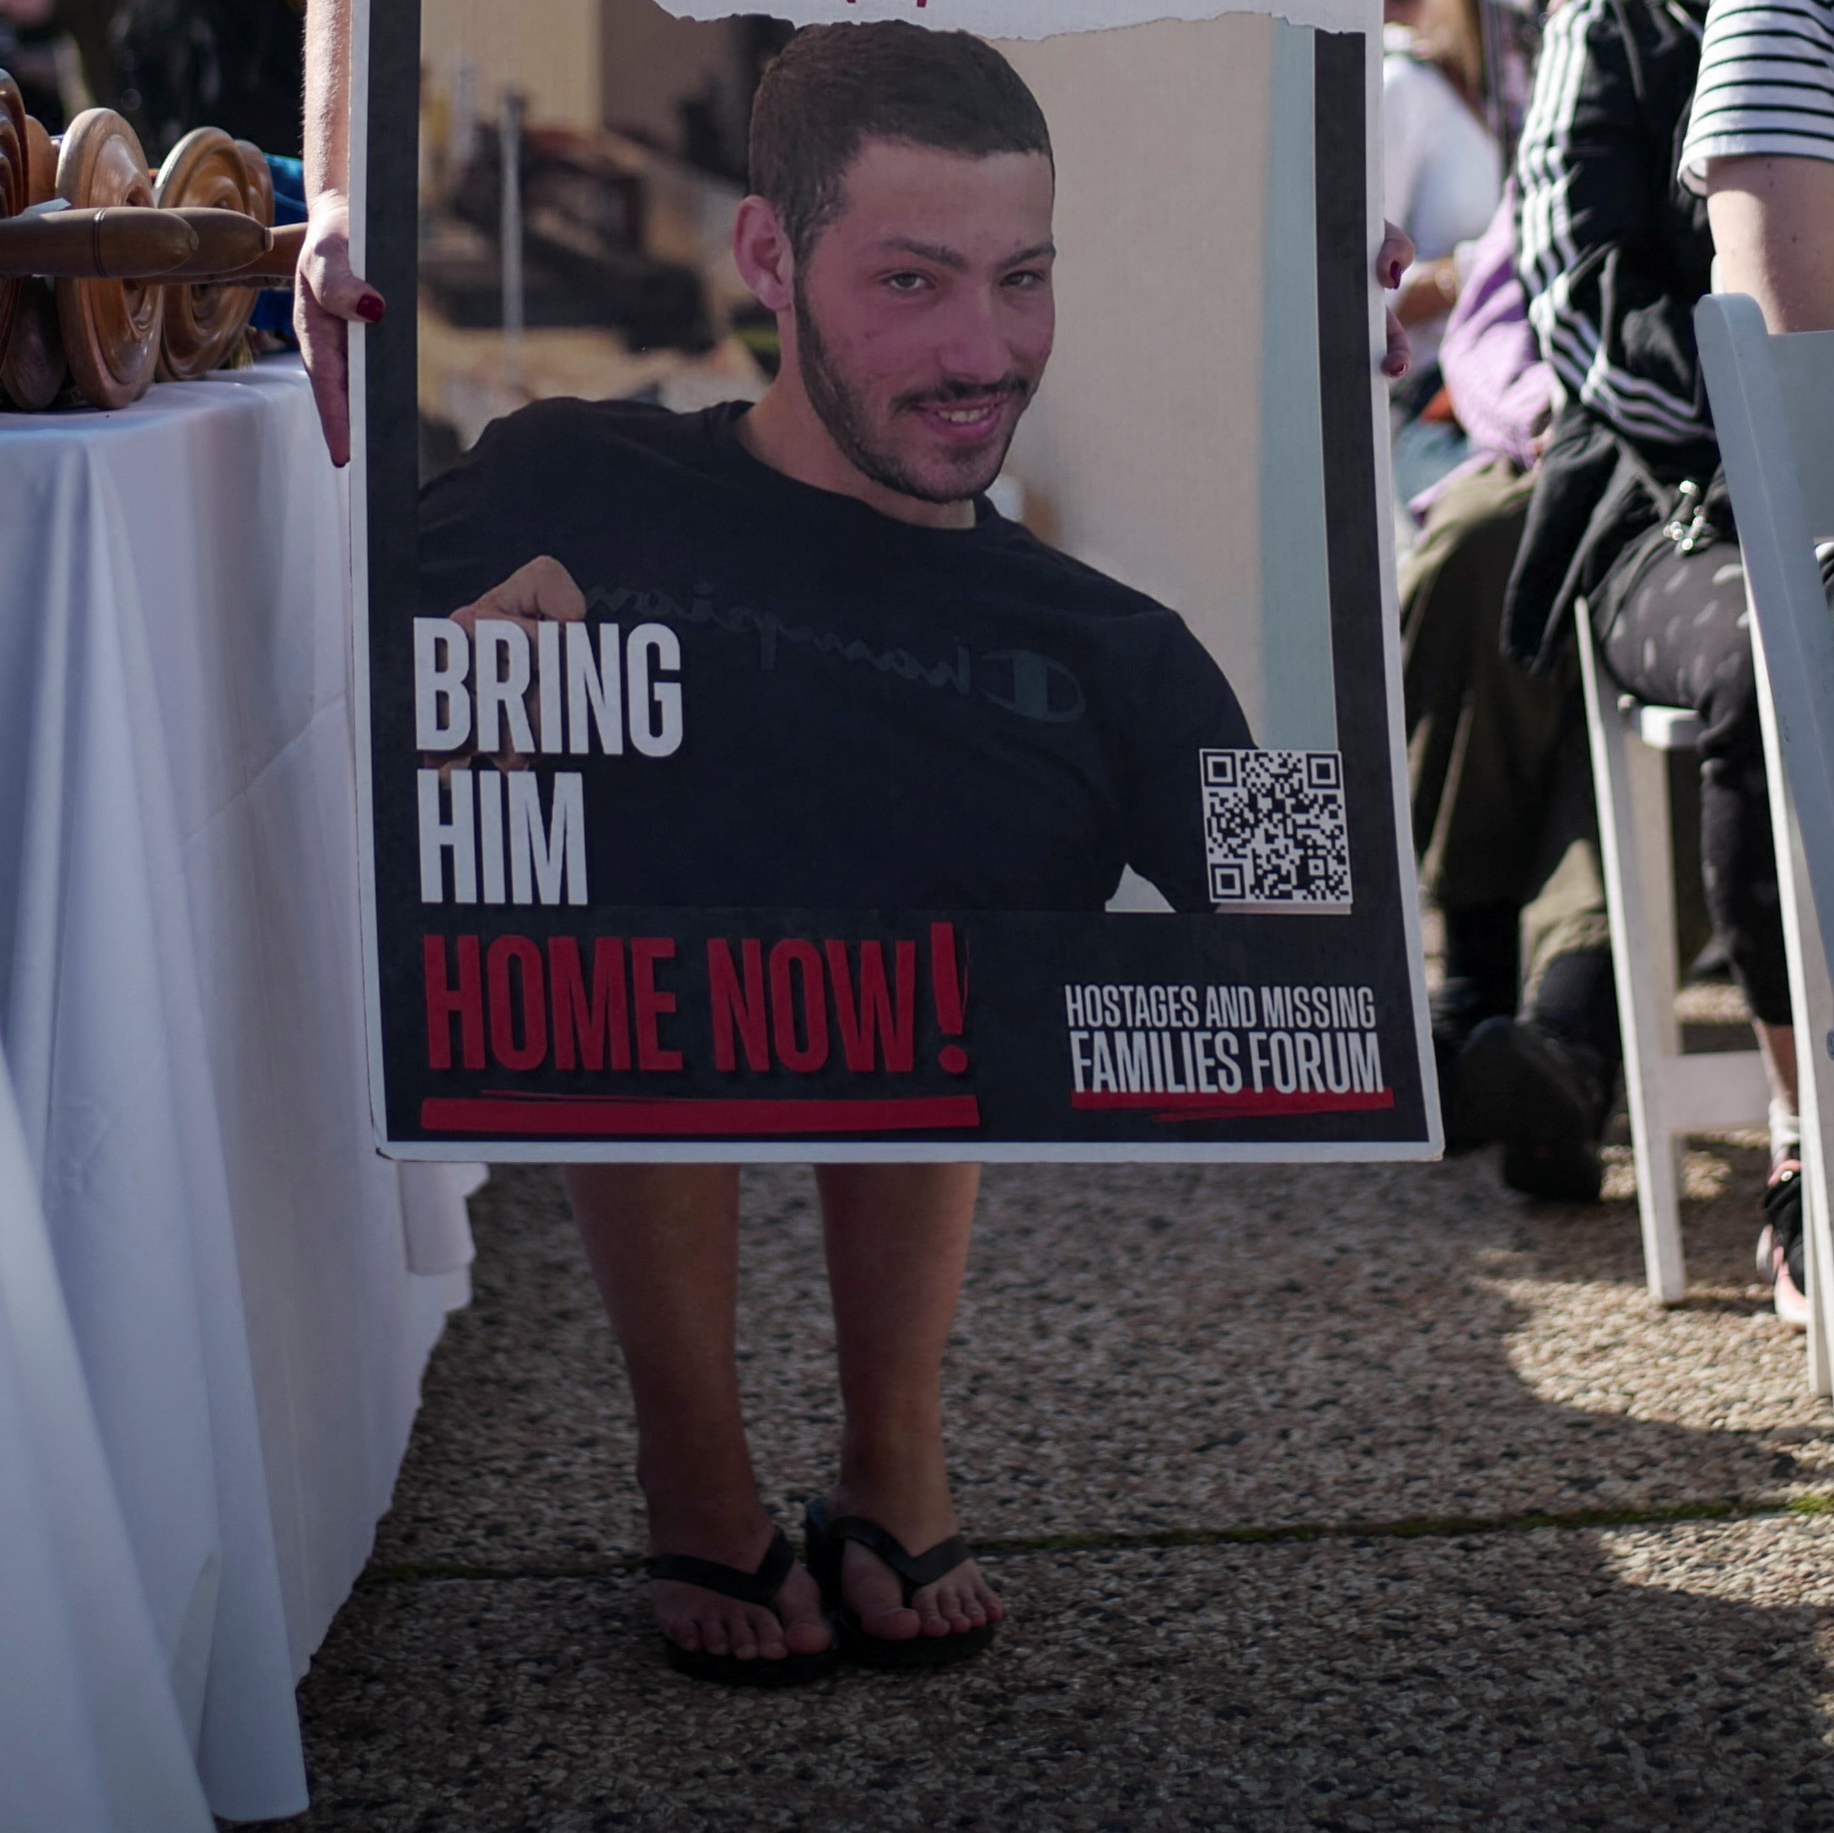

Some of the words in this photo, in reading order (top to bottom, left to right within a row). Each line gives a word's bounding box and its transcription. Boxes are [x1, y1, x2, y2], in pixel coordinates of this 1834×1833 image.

[413, 617, 684, 758] BRING
[417, 768, 588, 906] HIM
[422, 933, 684, 1072] HOME
[706, 920, 970, 1074] NOW!
[1065, 984, 1200, 1028] HOSTAGES
[1205, 985, 1257, 1029] AND
[1260, 986, 1376, 1029] MISSING
[1070, 1030, 1243, 1094] FAMILIES
[1248, 1031, 1385, 1094] FORUM
